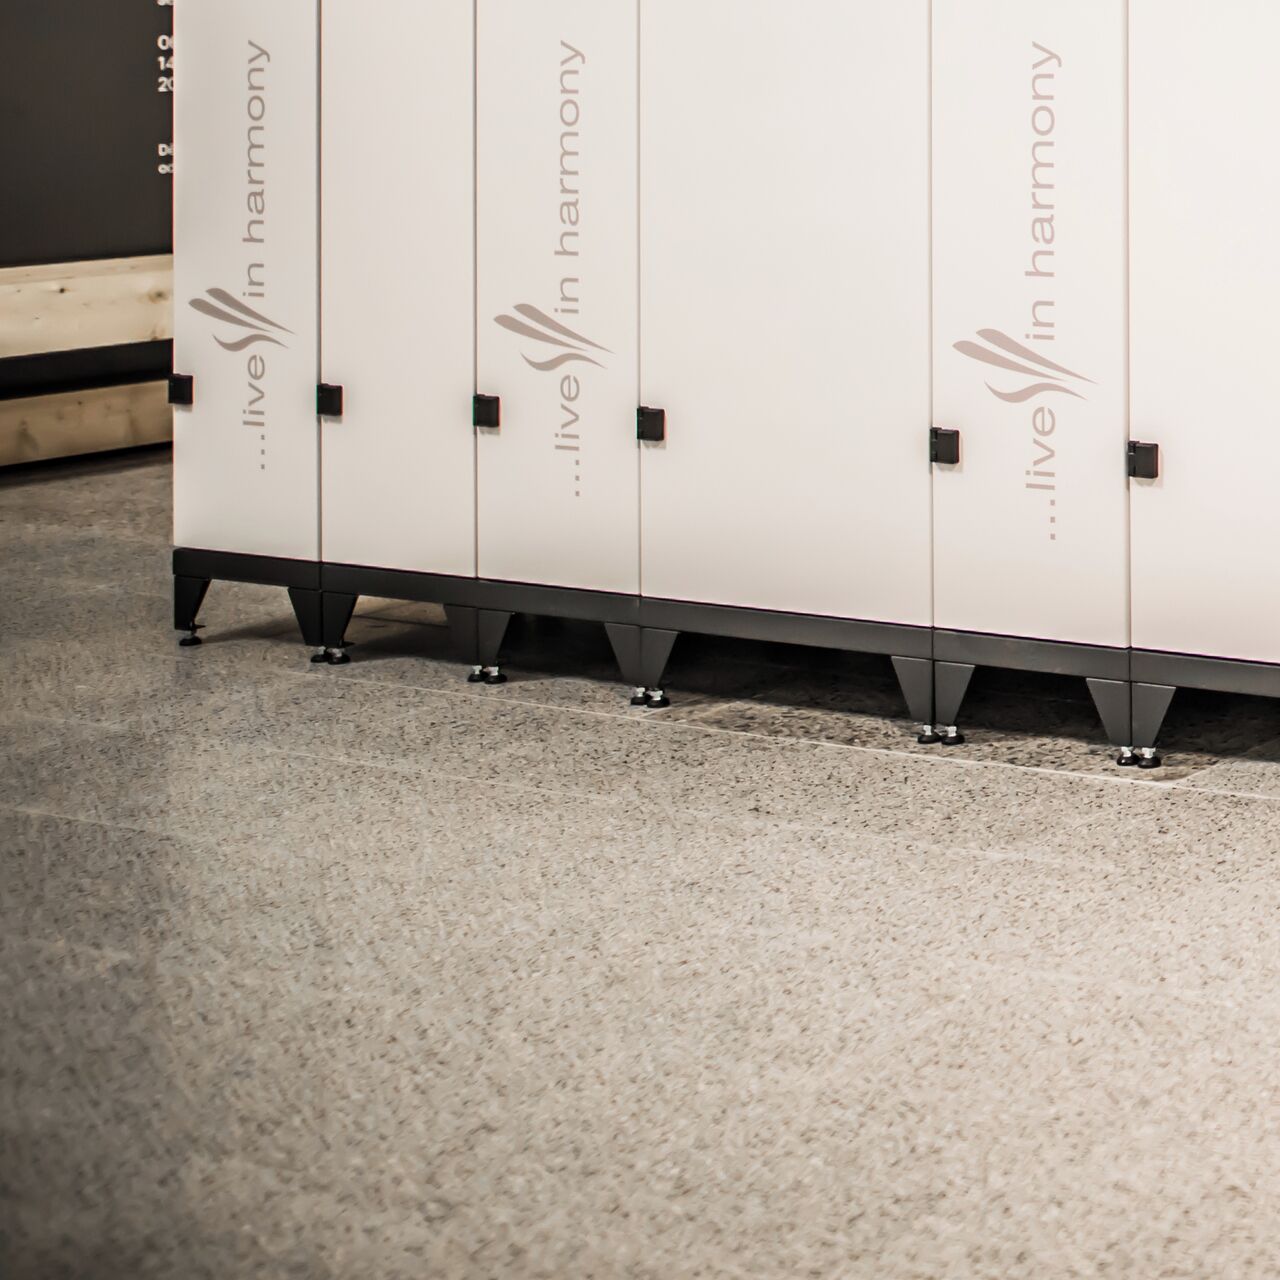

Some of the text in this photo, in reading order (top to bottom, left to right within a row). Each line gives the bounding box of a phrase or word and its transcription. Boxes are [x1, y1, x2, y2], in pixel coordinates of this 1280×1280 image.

[243, 40, 271, 470] ...live in harmony
[554, 40, 587, 497] ...live in harmony
[1025, 40, 1063, 541] ...live in harmony
